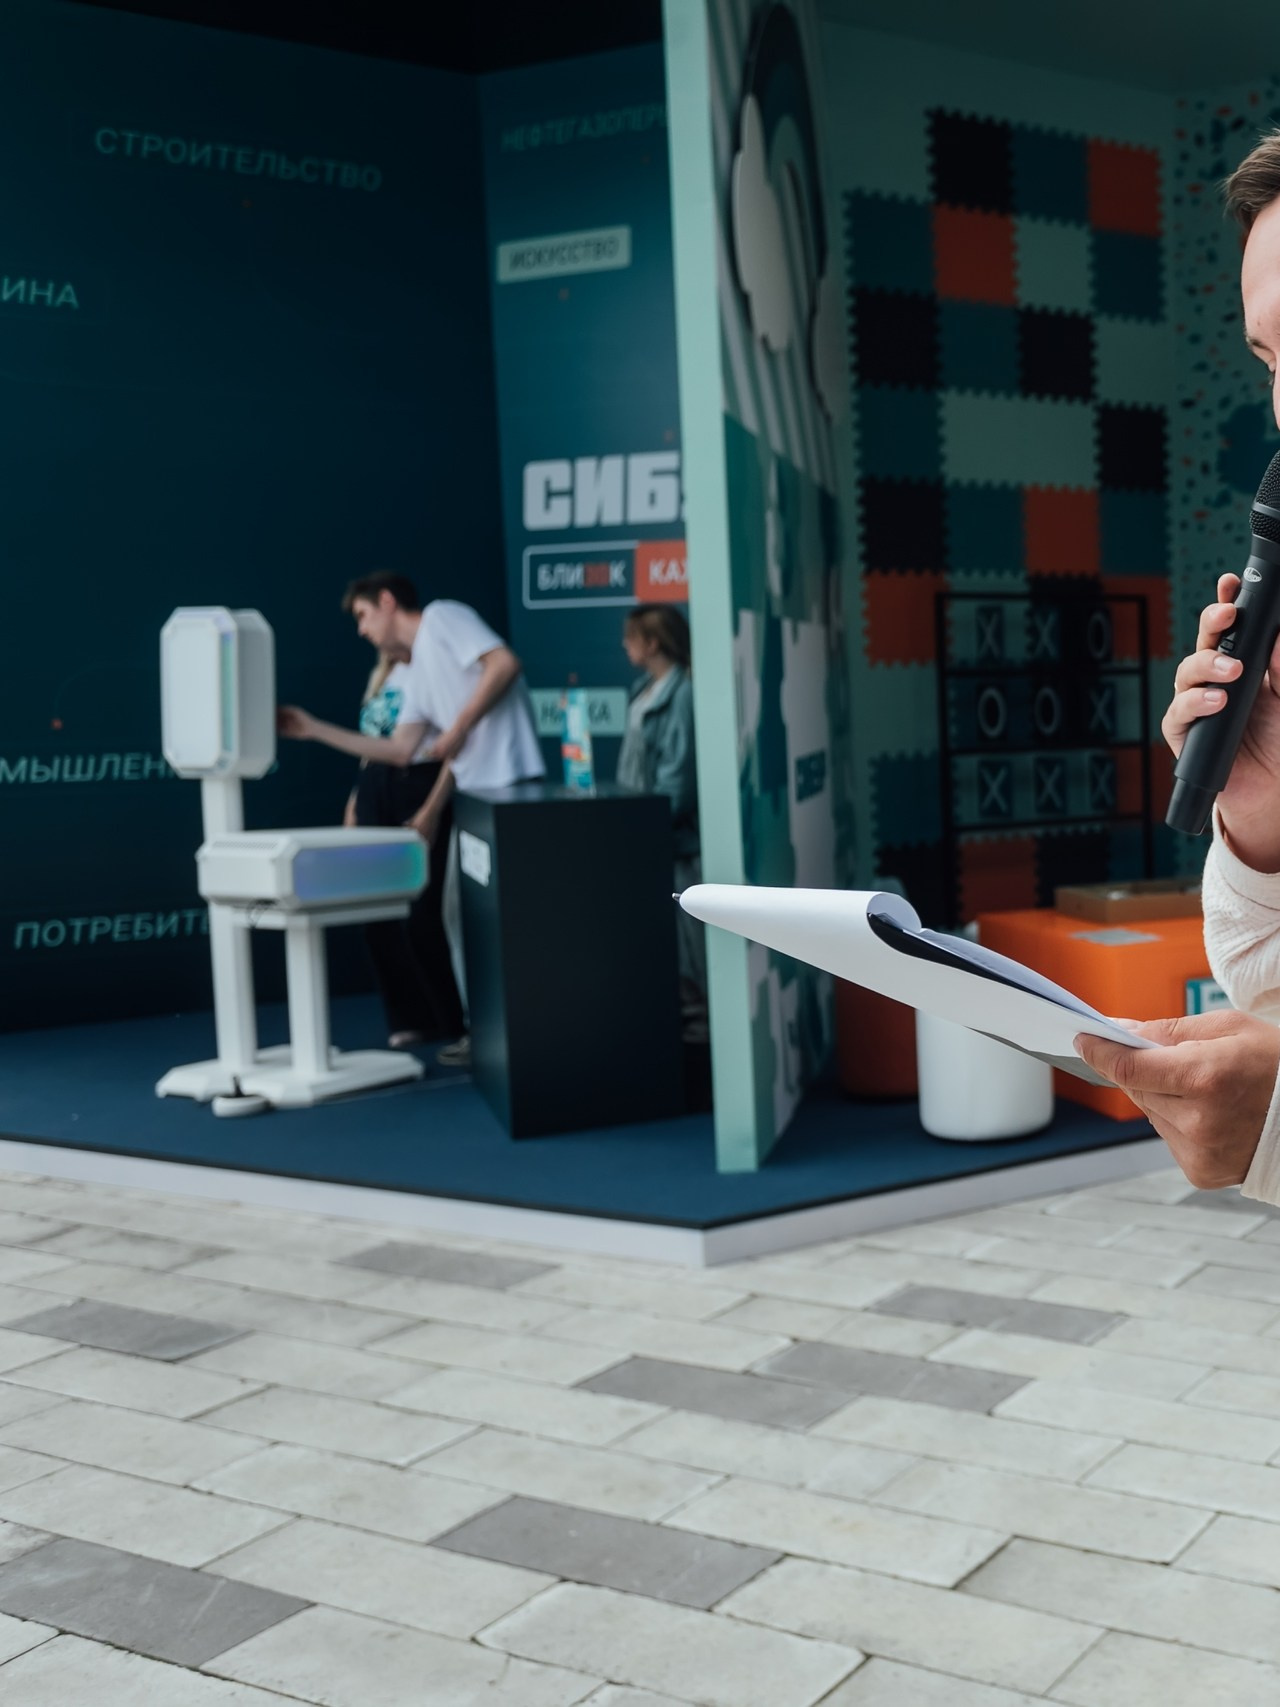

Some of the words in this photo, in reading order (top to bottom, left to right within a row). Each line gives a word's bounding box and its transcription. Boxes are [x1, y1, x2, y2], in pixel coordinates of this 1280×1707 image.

[94, 127, 382, 192] СТРОИТЕЛЬСТВО
[510, 236, 621, 270] ИСКУССТВО
[522, 450, 685, 532] СИБ
